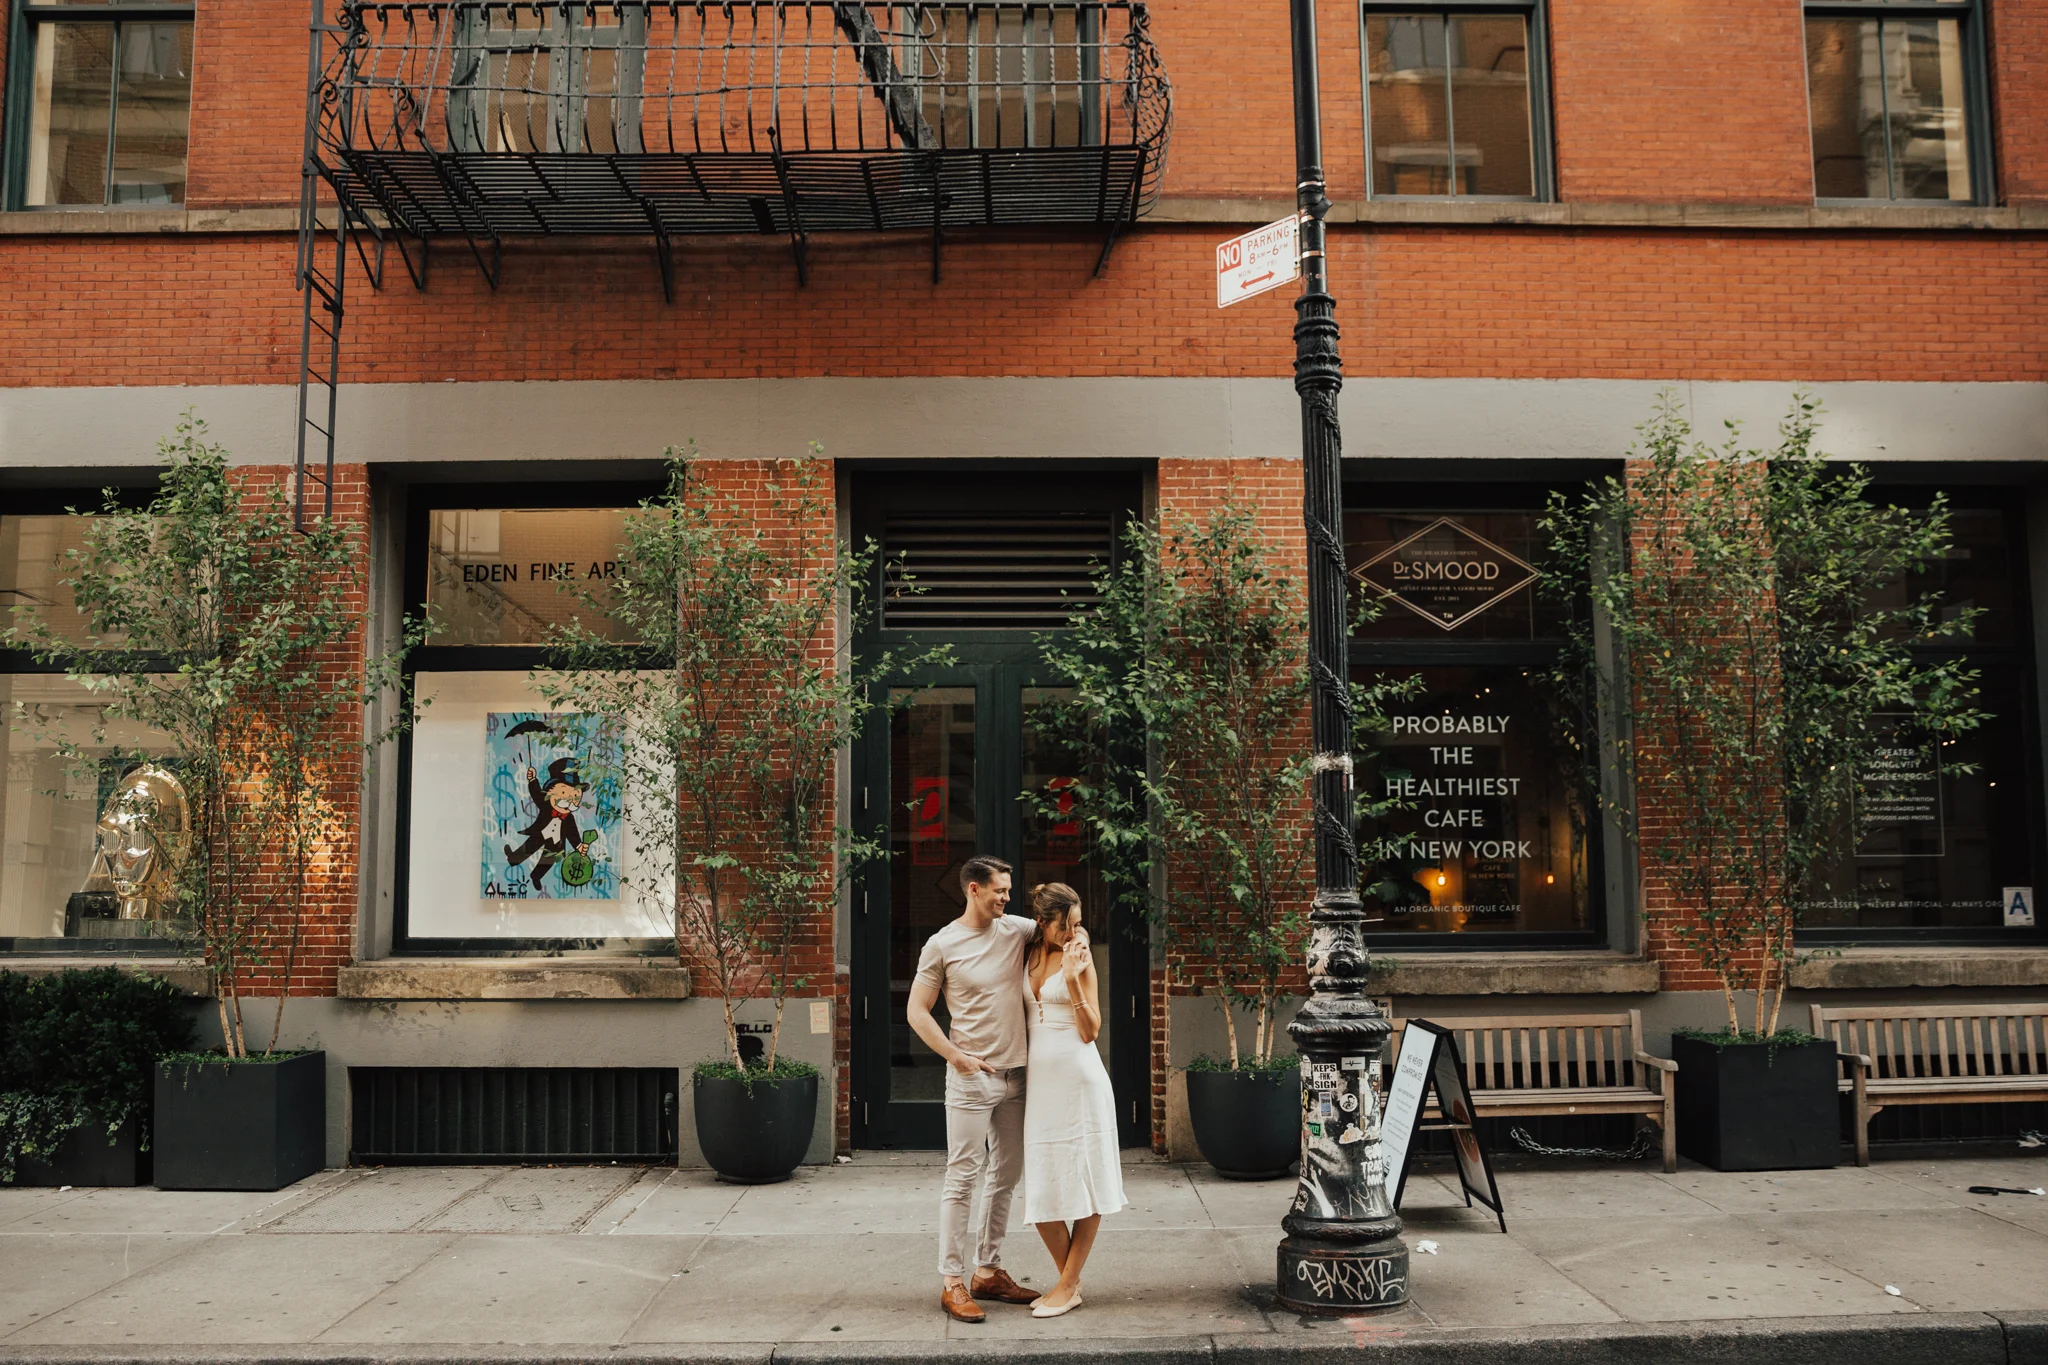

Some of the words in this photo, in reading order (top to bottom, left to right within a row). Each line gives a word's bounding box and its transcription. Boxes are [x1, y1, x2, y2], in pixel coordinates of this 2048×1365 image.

[1220, 244, 1240, 270] NO
[1247, 226, 1290, 252] PARKING
[1238, 269, 1252, 278] MON
[1266, 260, 1278, 268] FRI
[463, 564, 518, 582] EDEN
[530, 562, 576, 581] FINE
[588, 561, 632, 580] ART
[1393, 716, 1510, 734] PROBABLY
[1430, 747, 1474, 764] THE
[1386, 778, 1520, 796] HEALTHIEST
[1424, 810, 1484, 828] CAFE
[1379, 842, 1401, 860] IN
[1410, 842, 1462, 859] NEW
[1469, 840, 1532, 858] YORK
[2009, 892, 2028, 915] A
[736, 1024, 772, 1033] ELLO
[1314, 1064, 1336, 1072] KEPS
